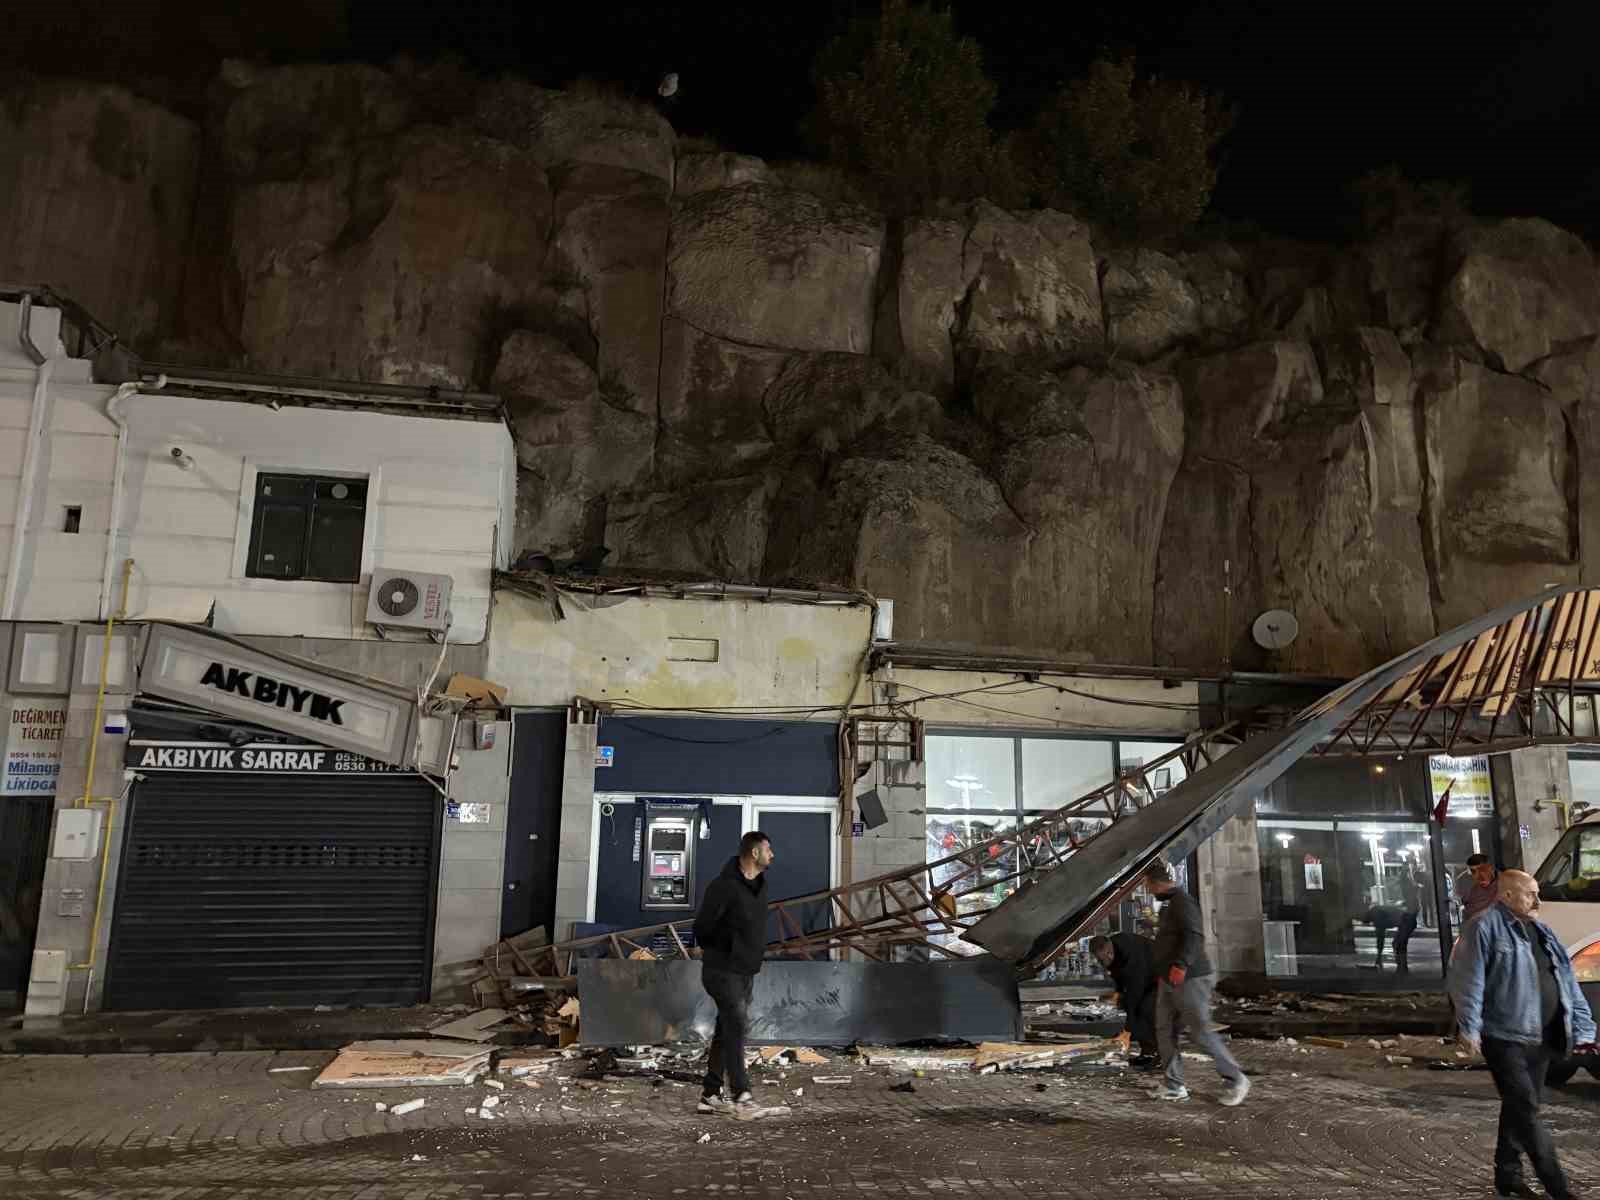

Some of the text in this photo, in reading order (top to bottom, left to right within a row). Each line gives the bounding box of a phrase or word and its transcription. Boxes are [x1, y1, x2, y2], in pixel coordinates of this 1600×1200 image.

[200, 662, 345, 725] AKBIYIK
[140, 748, 326, 770] AKBIYIK SARRAF
[335, 762, 366, 771] 0530
